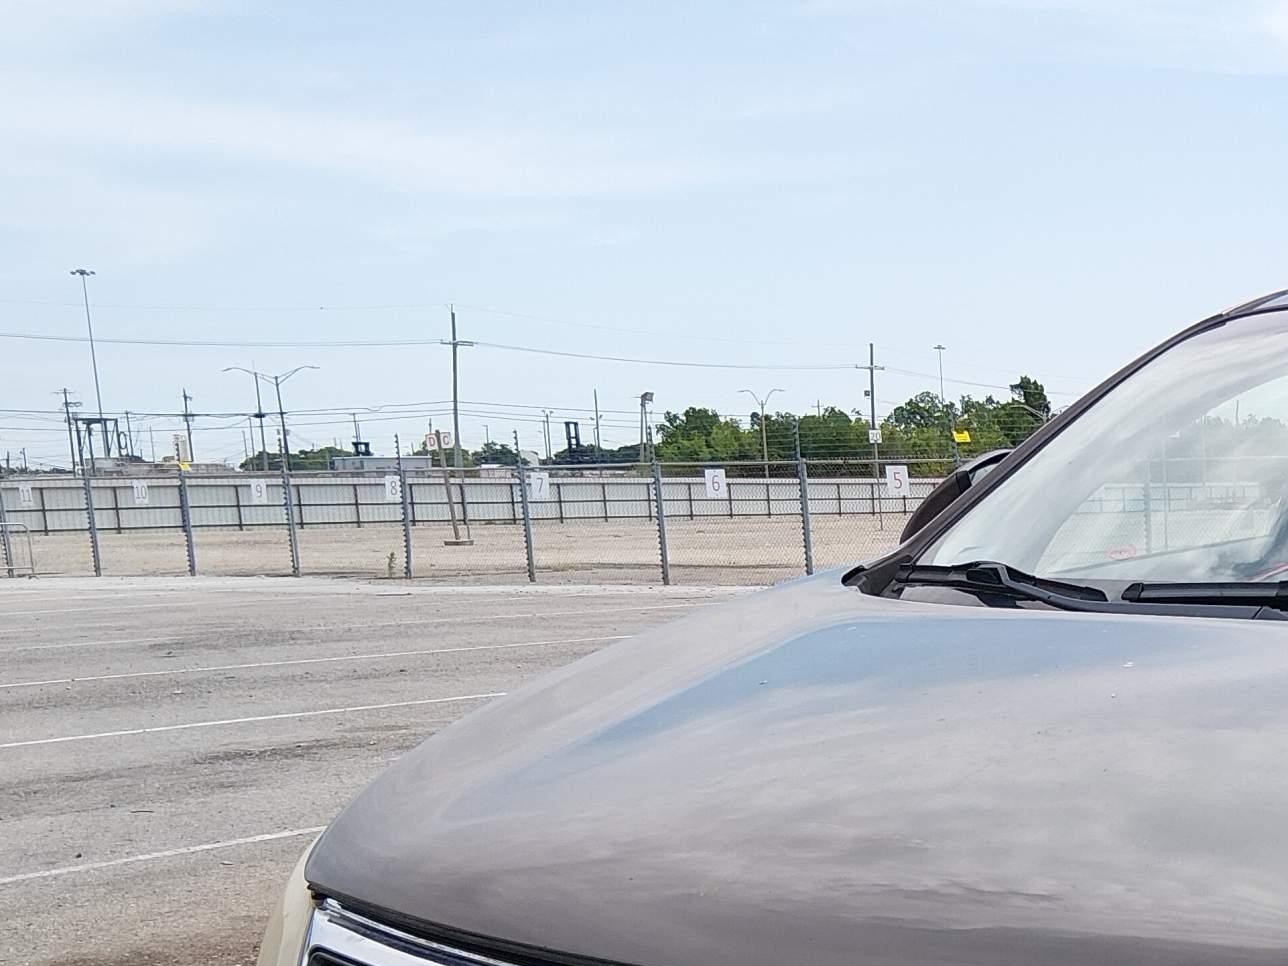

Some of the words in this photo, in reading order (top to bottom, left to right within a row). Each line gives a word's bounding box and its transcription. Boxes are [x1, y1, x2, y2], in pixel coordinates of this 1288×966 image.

[428, 436, 436, 447] D
[442, 435, 450, 446] C
[535, 477, 544, 494] 7
[711, 475, 720, 491] 6
[893, 471, 902, 489] 5
[21, 489, 32, 502] 11
[135, 485, 147, 500] 10
[255, 483, 263, 497] 9
[389, 480, 398, 496] 8
